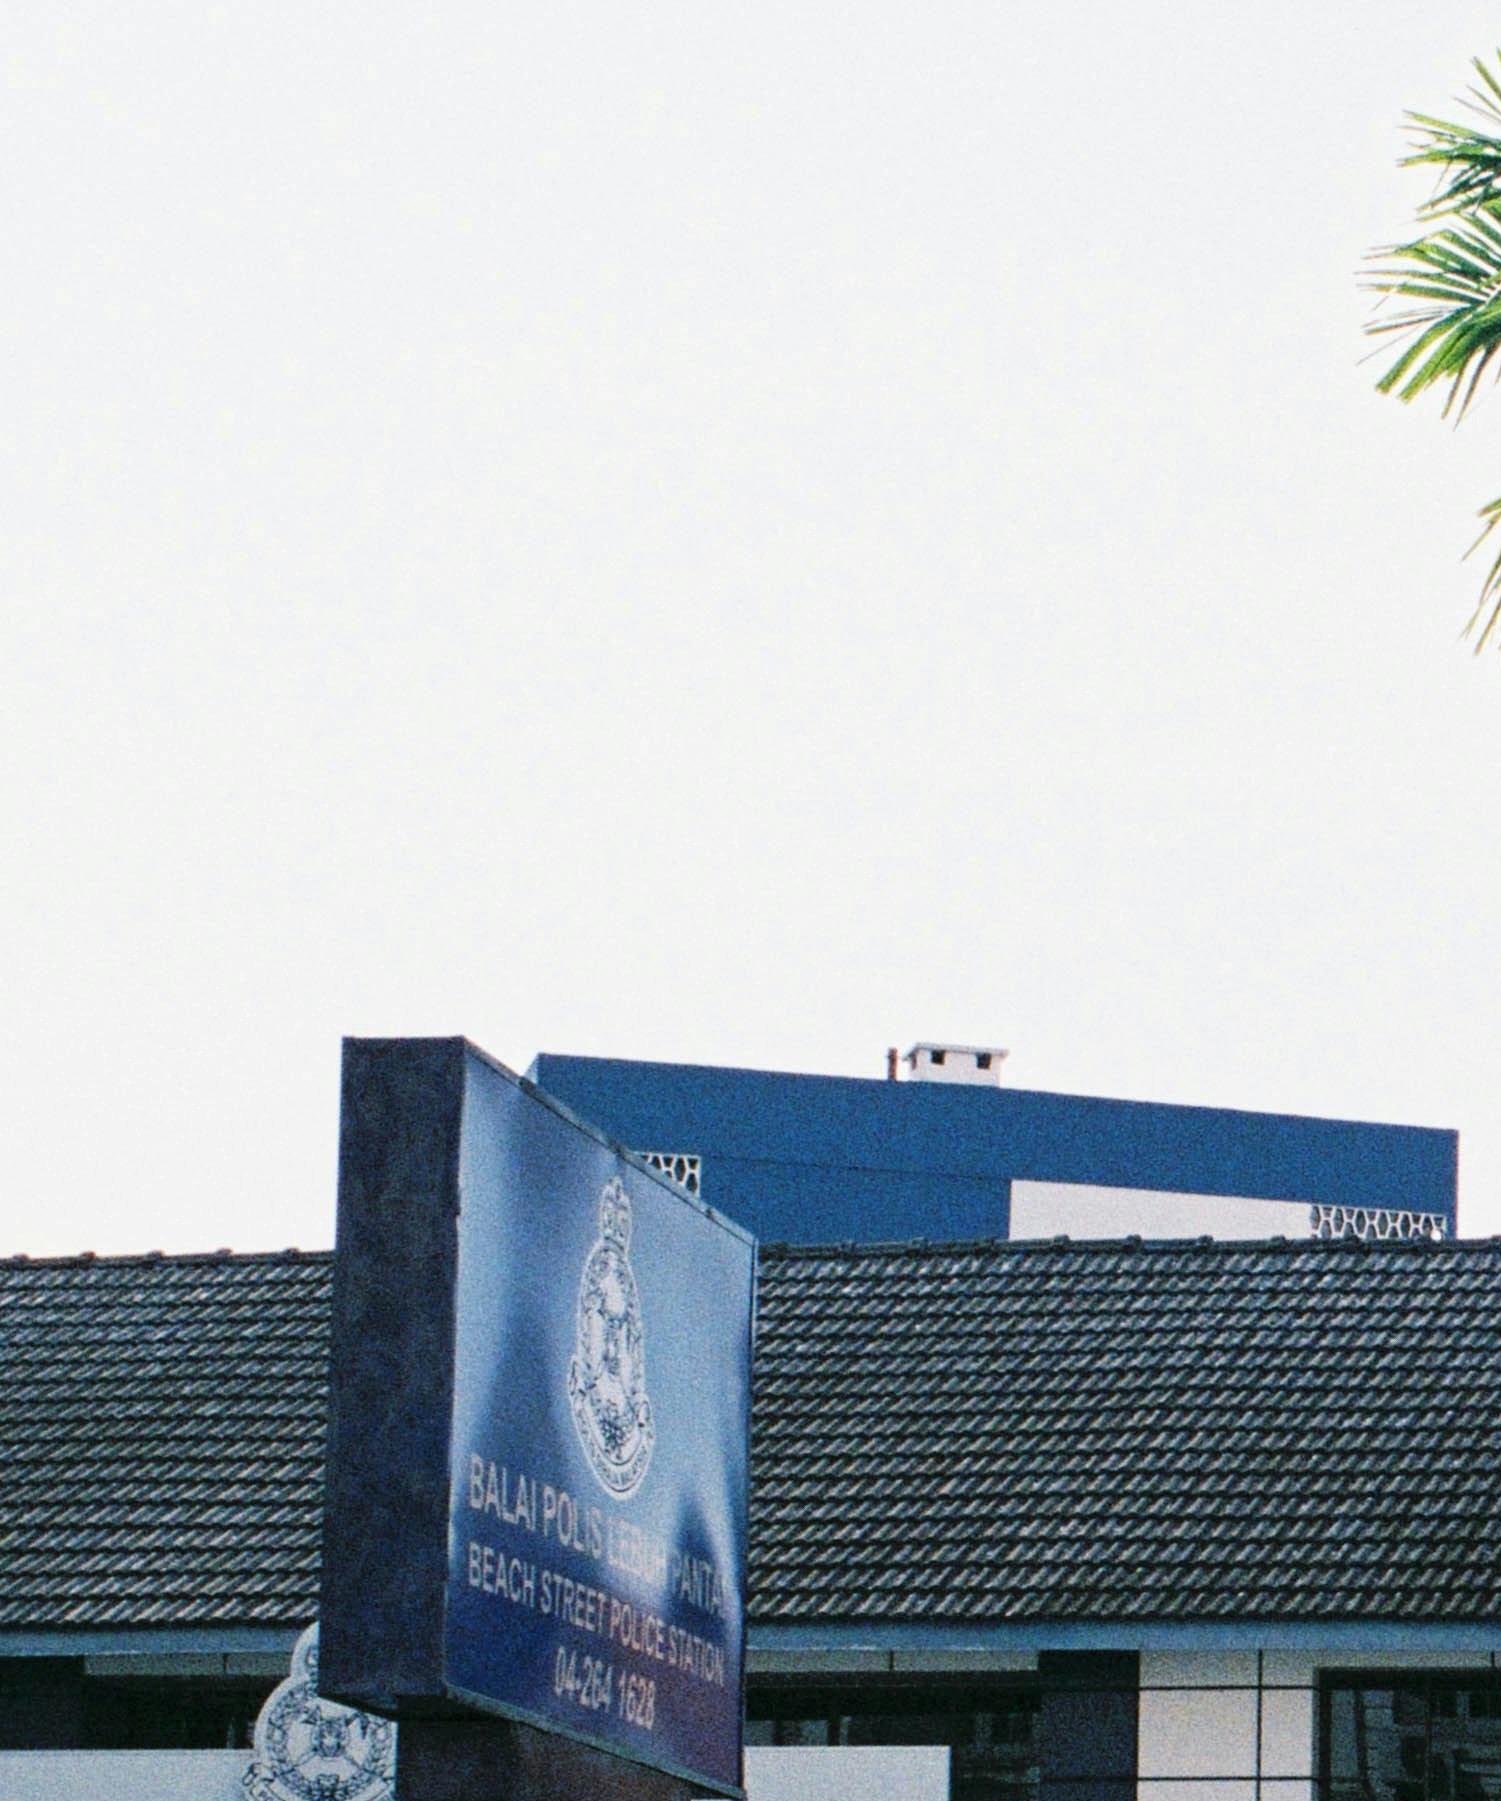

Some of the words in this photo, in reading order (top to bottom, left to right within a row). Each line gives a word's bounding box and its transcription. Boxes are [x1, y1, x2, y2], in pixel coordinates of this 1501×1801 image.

[469, 1454, 536, 1531] BALAI
[542, 1486, 602, 1560] POLIS
[468, 1541, 535, 1608] BEACH
[541, 1569, 606, 1635] STREET
[609, 1598, 665, 1661] POLICE
[668, 1623, 725, 1687] STATION
